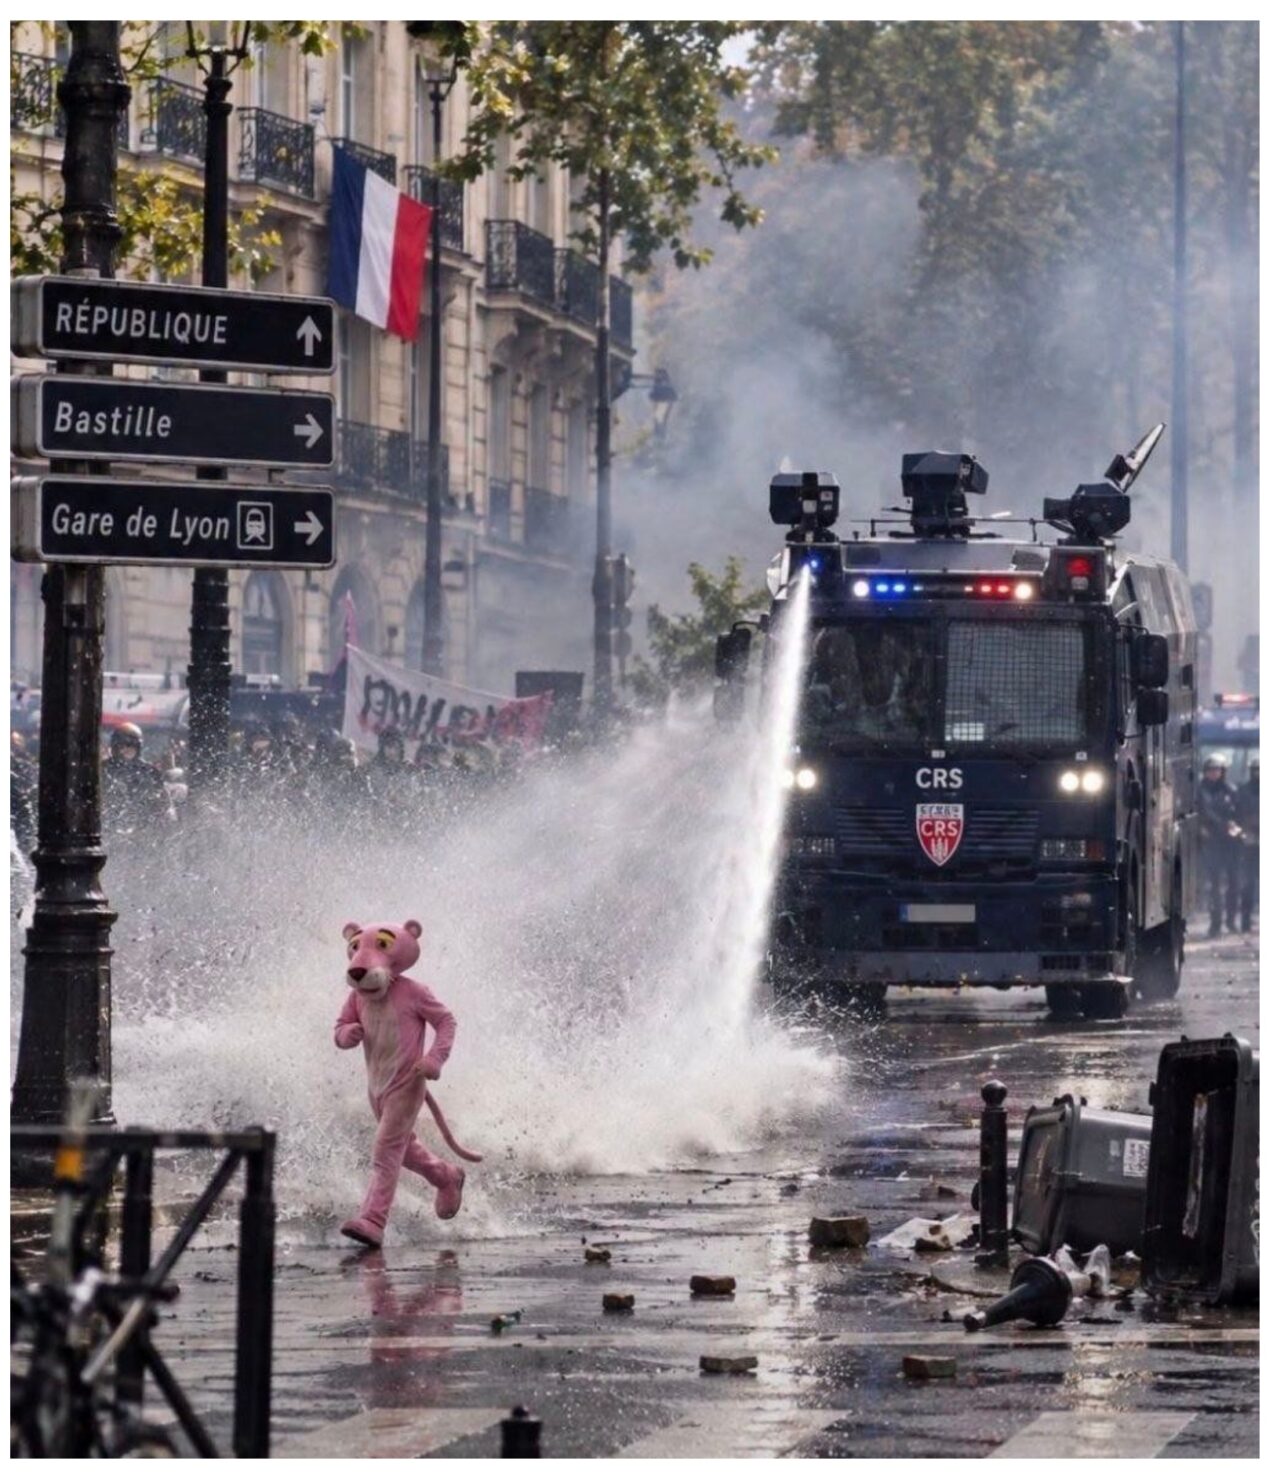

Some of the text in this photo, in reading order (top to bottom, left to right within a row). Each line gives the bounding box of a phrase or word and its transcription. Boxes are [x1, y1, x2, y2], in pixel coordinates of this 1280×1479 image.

[55, 298, 228, 344] RÉPUBLIQUE
[54, 402, 172, 437] Bastille
[52, 504, 230, 545] Gare de Lyon
[915, 768, 963, 788] CRS
[921, 821, 958, 837] CRS
